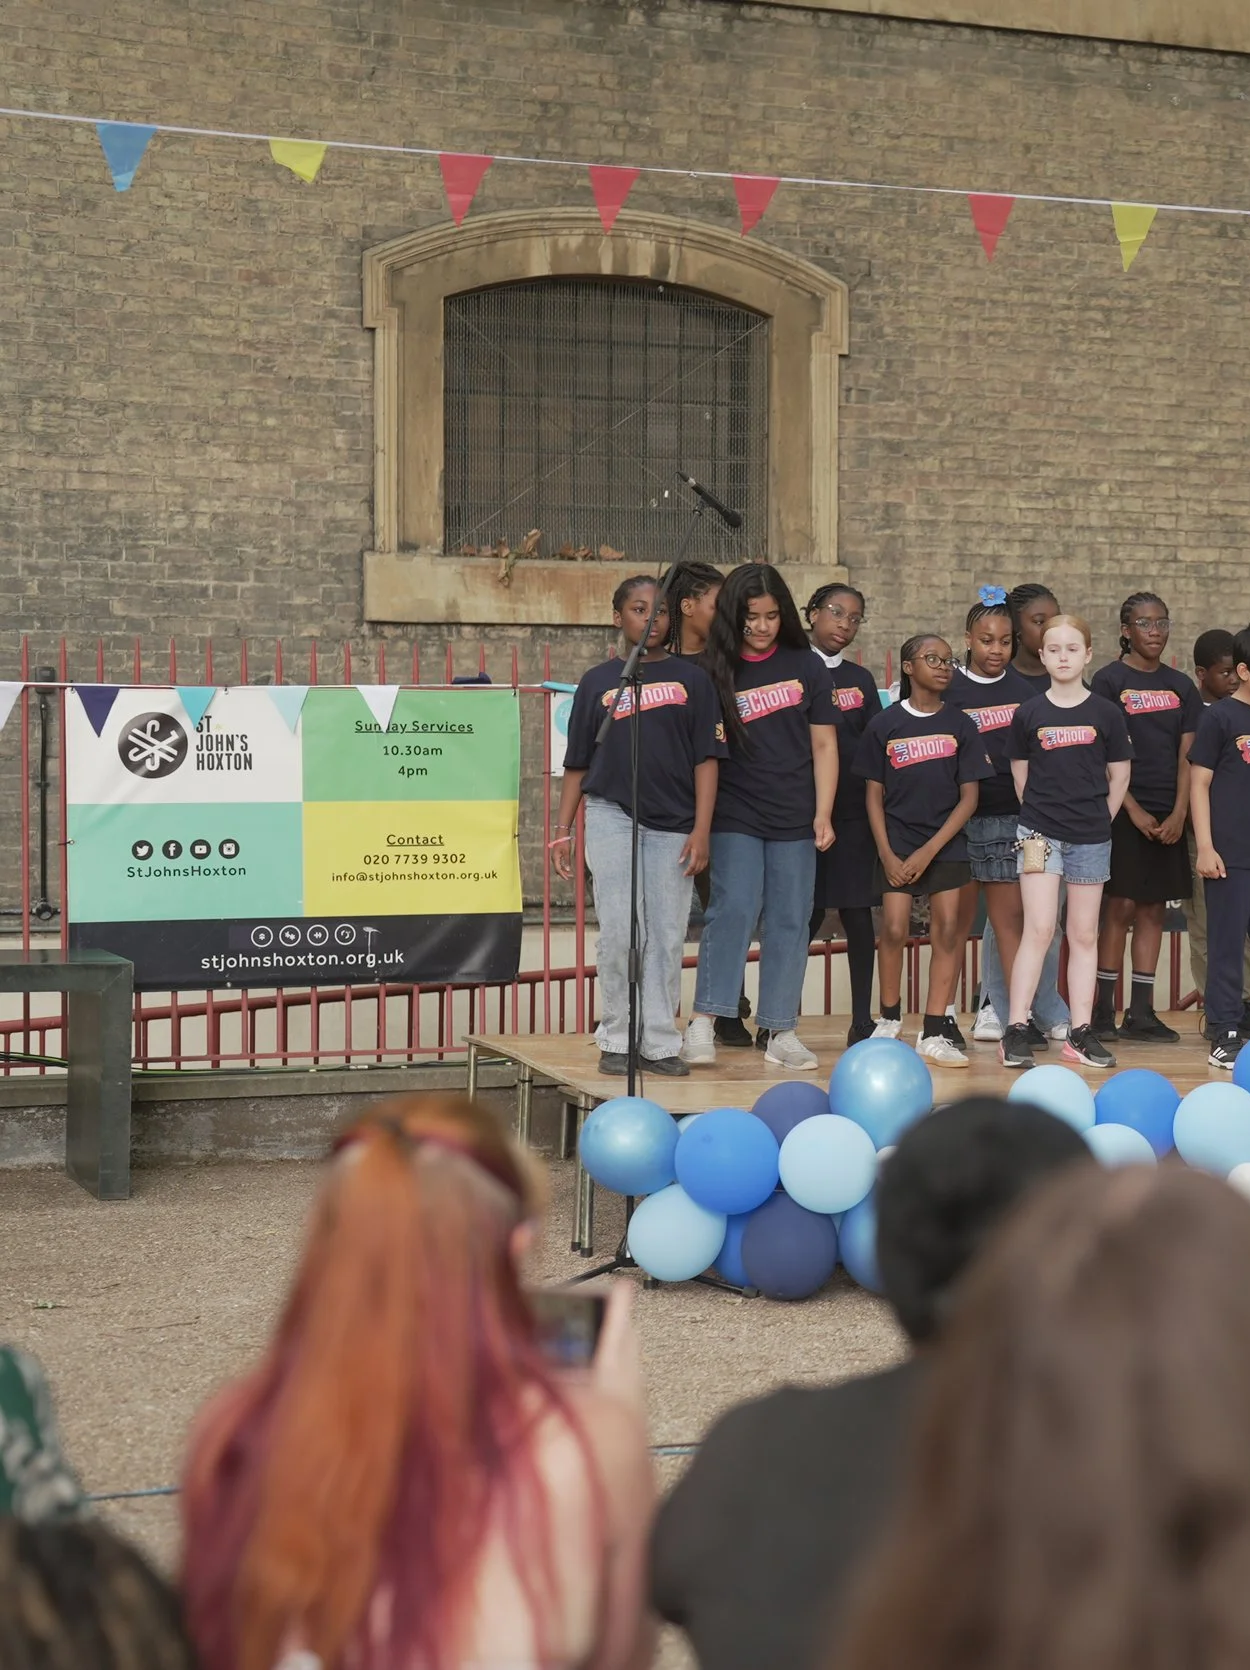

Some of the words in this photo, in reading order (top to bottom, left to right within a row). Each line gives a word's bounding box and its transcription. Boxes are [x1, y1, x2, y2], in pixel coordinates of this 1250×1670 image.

[748, 684, 790, 713] Choir
[838, 689, 856, 707] oir
[1130, 693, 1143, 710] SJB
[1140, 690, 1172, 709] Choir
[196, 715, 212, 733] ST
[411, 720, 474, 734] Services
[196, 734, 248, 752] JOHN'S
[1056, 726, 1087, 744] Choir
[383, 745, 443, 756] 10.30am
[893, 742, 910, 763] SJB
[907, 736, 946, 759] Choir
[196, 753, 252, 771] HOXTON
[398, 765, 428, 778] 4pm
[386, 834, 444, 847] Contact
[363, 854, 390, 866] 020
[394, 853, 428, 865] 7739
[432, 852, 466, 865] 9302
[127, 865, 247, 878] StJohnsHoxton
[331, 870, 499, 884] info@stjohnshoxton.org.uk
[201, 949, 405, 972] stjohnshoxton.org.uk
